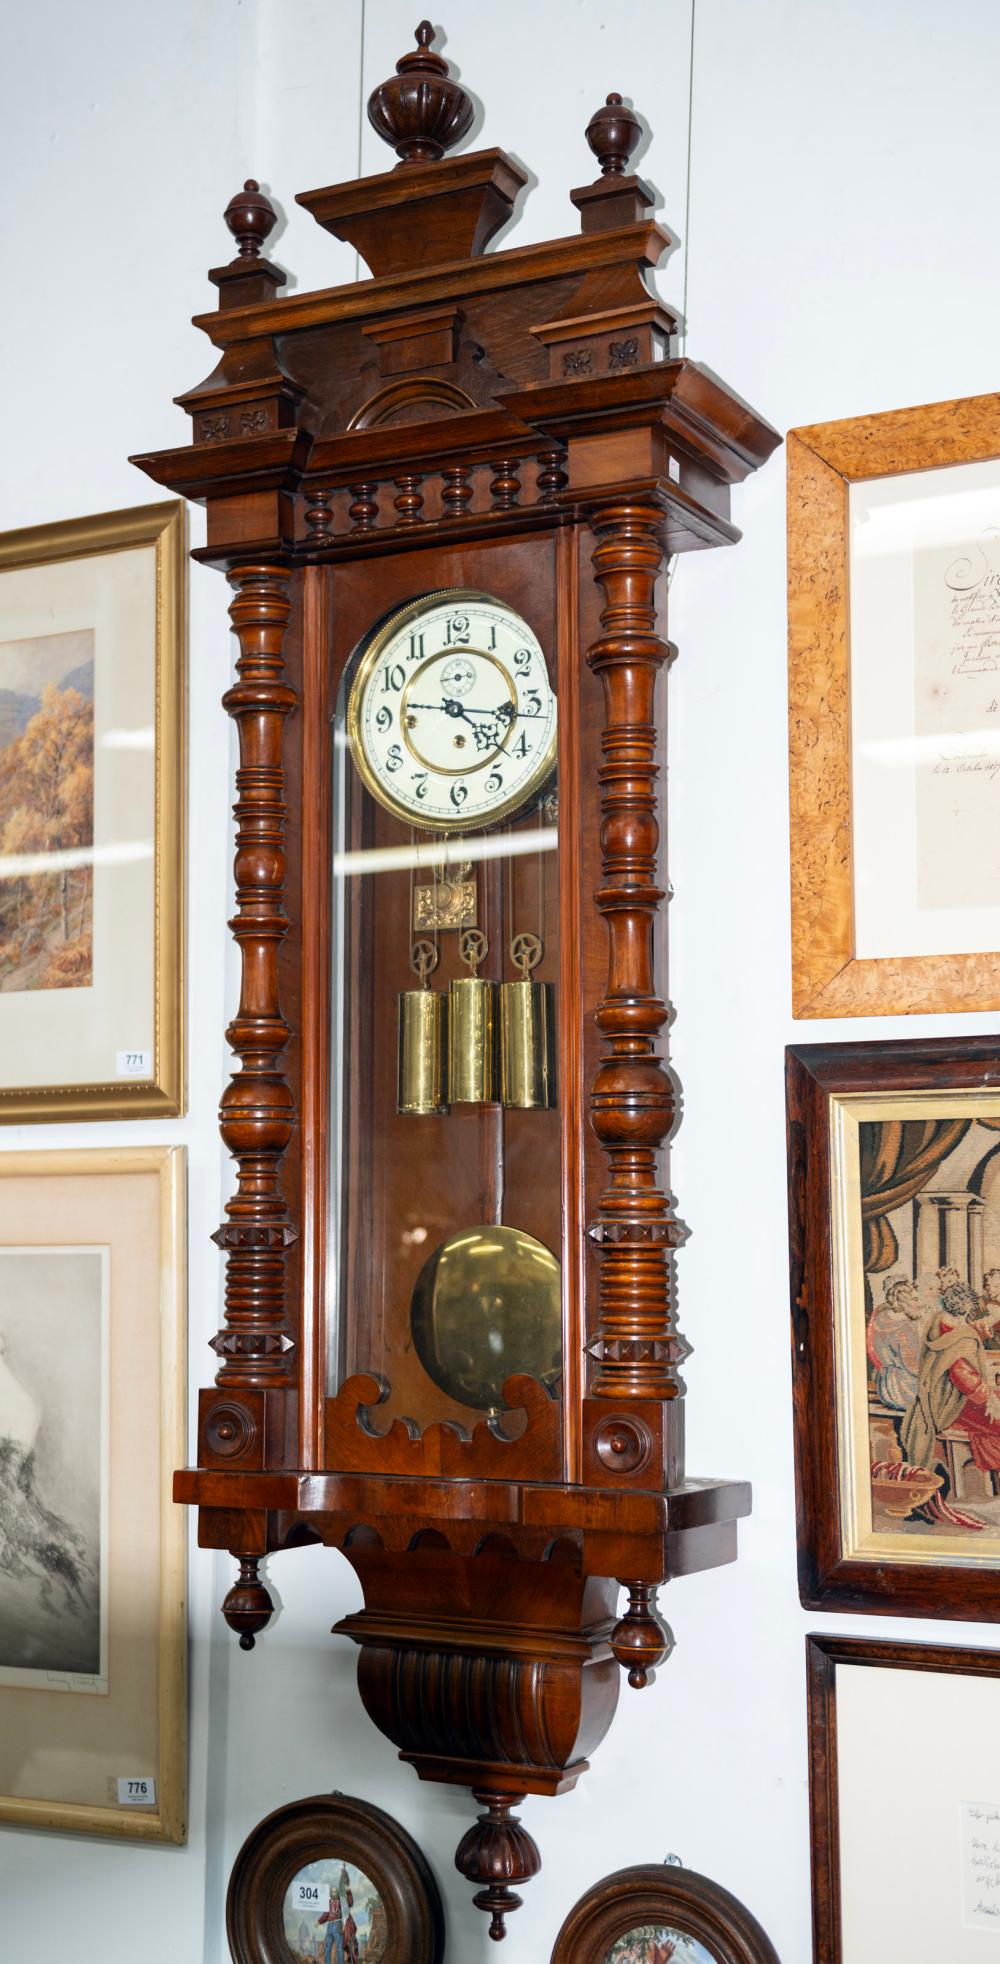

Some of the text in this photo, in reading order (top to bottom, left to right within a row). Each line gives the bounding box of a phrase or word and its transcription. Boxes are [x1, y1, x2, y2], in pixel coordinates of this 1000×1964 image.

[443, 616, 470, 647] 12
[488, 624, 496, 650] 1
[406, 632, 425, 661] 11
[514, 649, 532, 677] 2
[381, 664, 406, 693] 10
[523, 688, 542, 717] 3
[376, 705, 393, 733] 9
[385, 744, 404, 772] 8
[512, 730, 533, 760] 4
[411, 773, 429, 799] 7
[485, 763, 503, 793] 5
[450, 778, 468, 807] 6
[126, 1054, 143, 1065] 771
[127, 1782, 147, 1794] 776
[299, 1886, 319, 1900] 304
